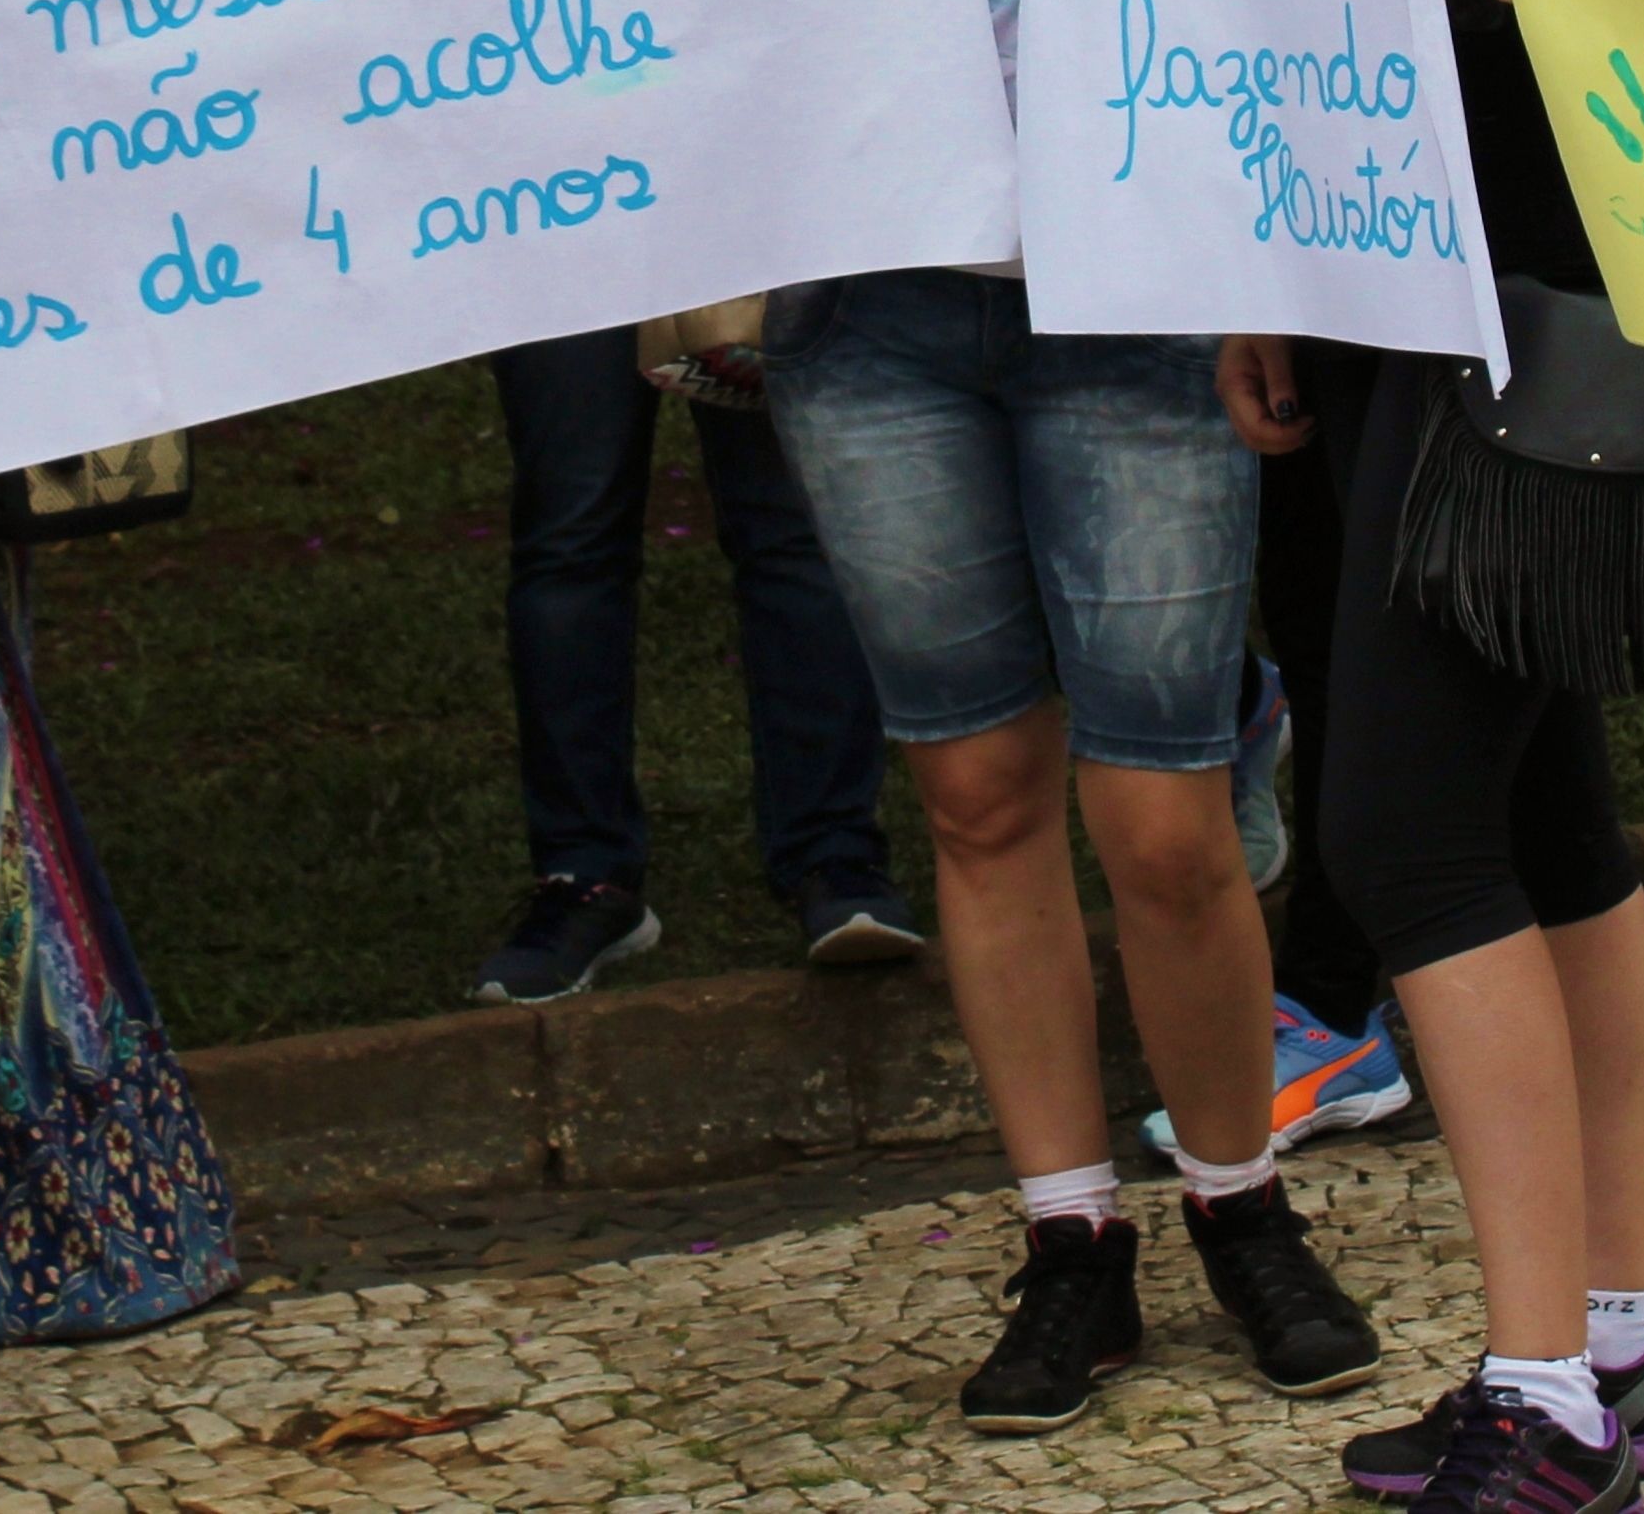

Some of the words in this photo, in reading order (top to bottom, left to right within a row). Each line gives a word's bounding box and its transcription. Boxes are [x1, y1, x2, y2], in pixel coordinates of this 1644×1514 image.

[52, 53, 260, 181] não
[139, 213, 262, 315] de
[305, 166, 350, 274] 4
[412, 155, 657, 258] anos
